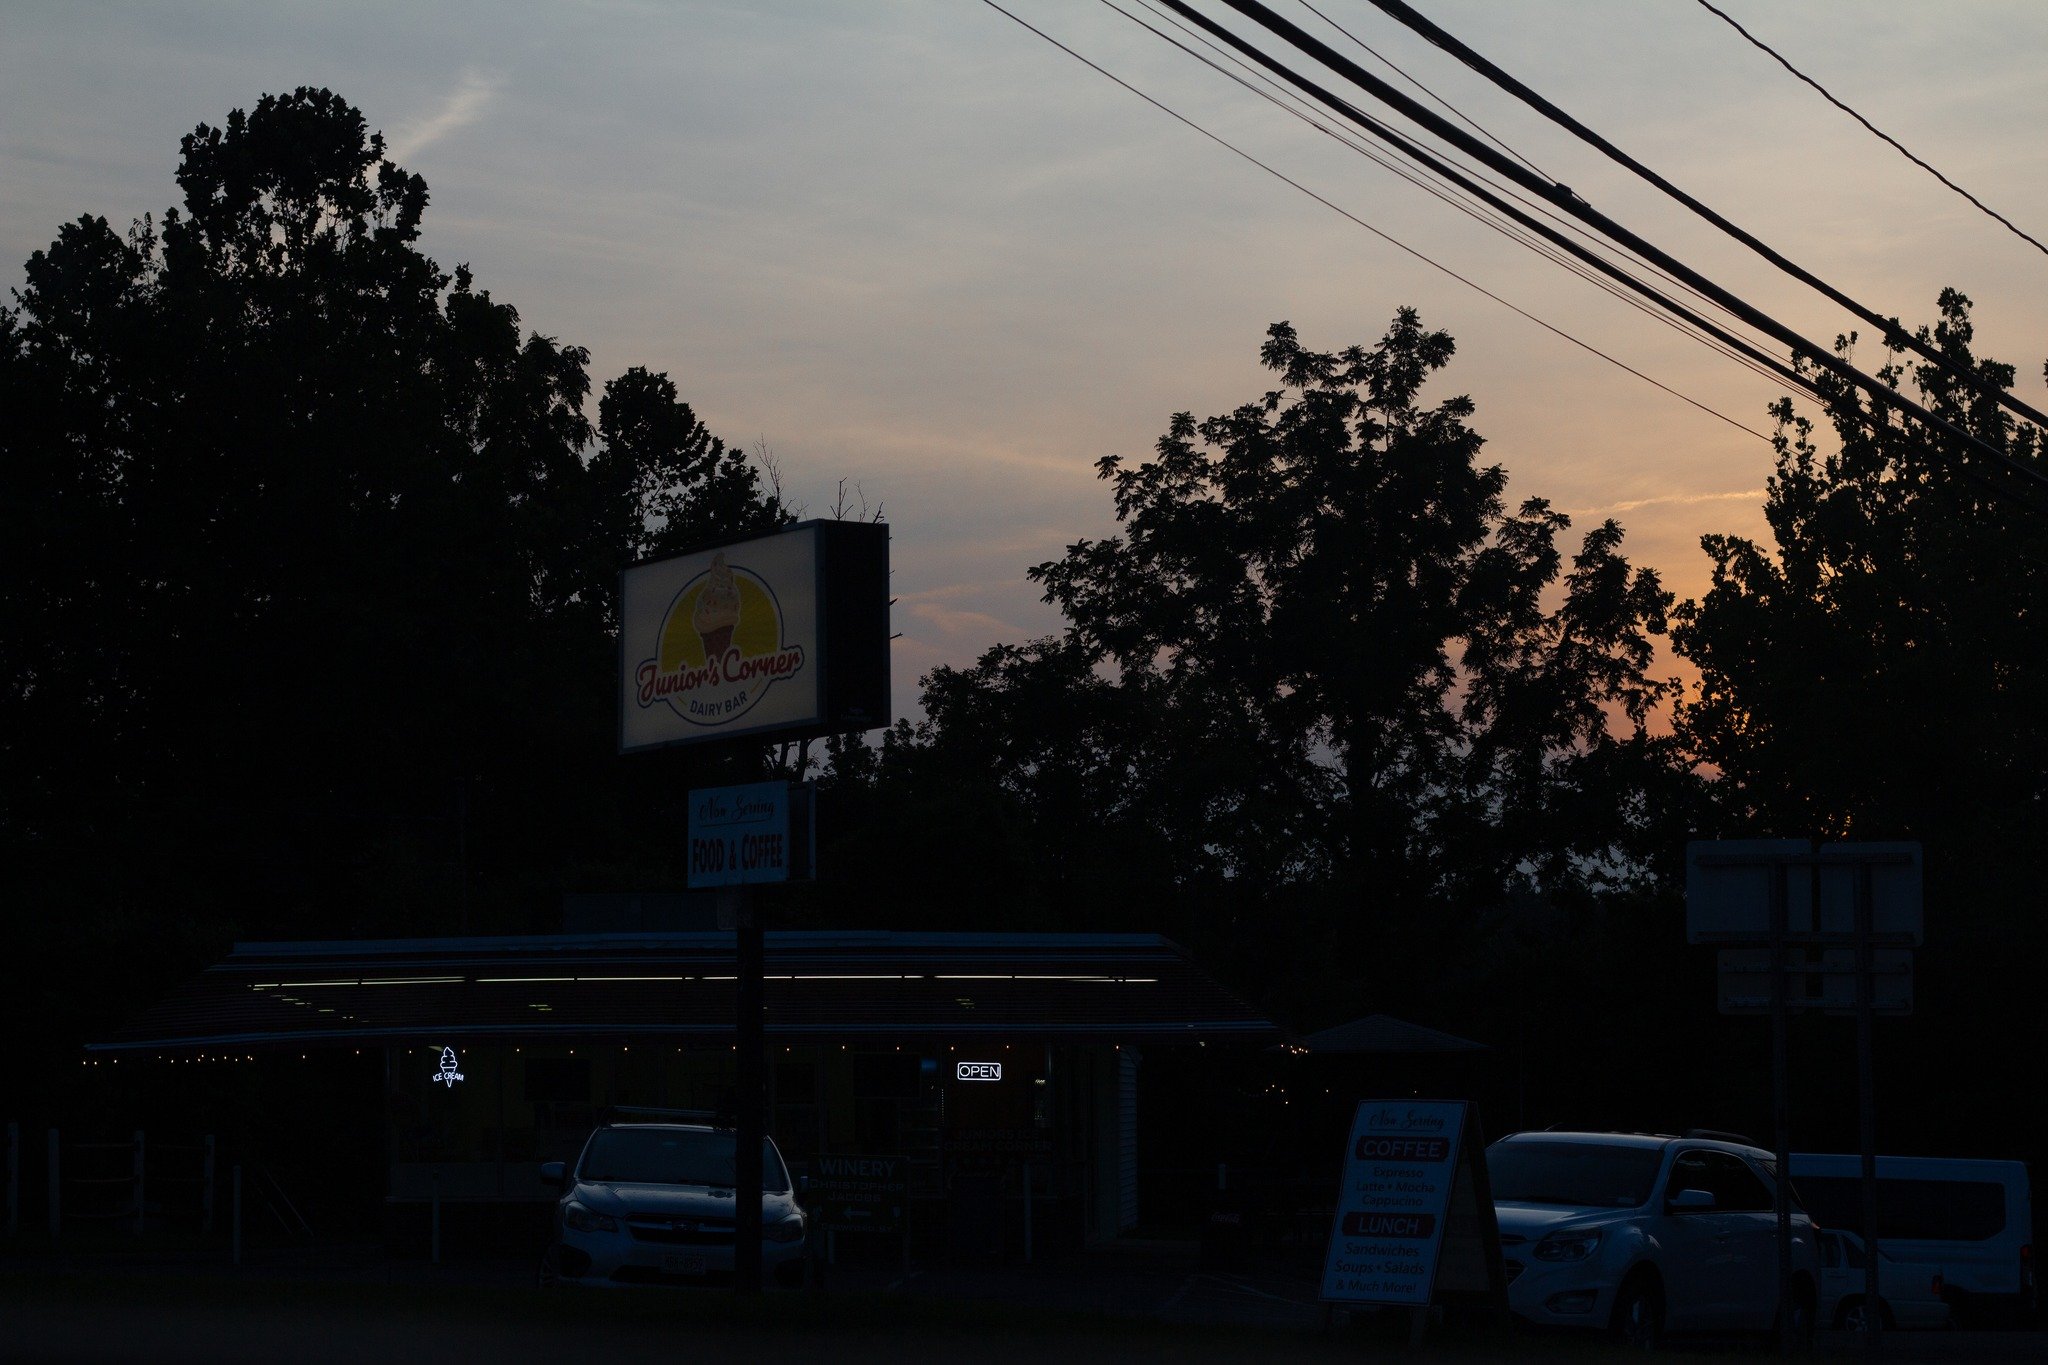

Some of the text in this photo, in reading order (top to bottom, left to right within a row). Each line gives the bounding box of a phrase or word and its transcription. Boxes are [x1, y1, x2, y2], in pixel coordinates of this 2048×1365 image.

[639, 648, 801, 702] Junior's Corner
[690, 691, 748, 717] DAIRY BAR
[699, 795, 775, 821] Now Serving
[692, 833, 783, 874] FOOD & COFFEE
[432, 1072, 464, 1082] ICE CREAM
[958, 1065, 1000, 1078] OPEN
[1369, 1109, 1445, 1131] Now Serving
[1363, 1140, 1442, 1157] COFFEE
[818, 1158, 896, 1177] WINERY
[1373, 1167, 1424, 1180] Expresso
[1356, 1181, 1435, 1192] Latte Mocha
[1362, 1195, 1423, 1208] Cappucino
[1358, 1216, 1420, 1234] LUNCH
[1344, 1243, 1420, 1257] Sandwiches
[1334, 1260, 1425, 1276] Soups Salads
[1335, 1280, 1416, 1293] & Much More!
